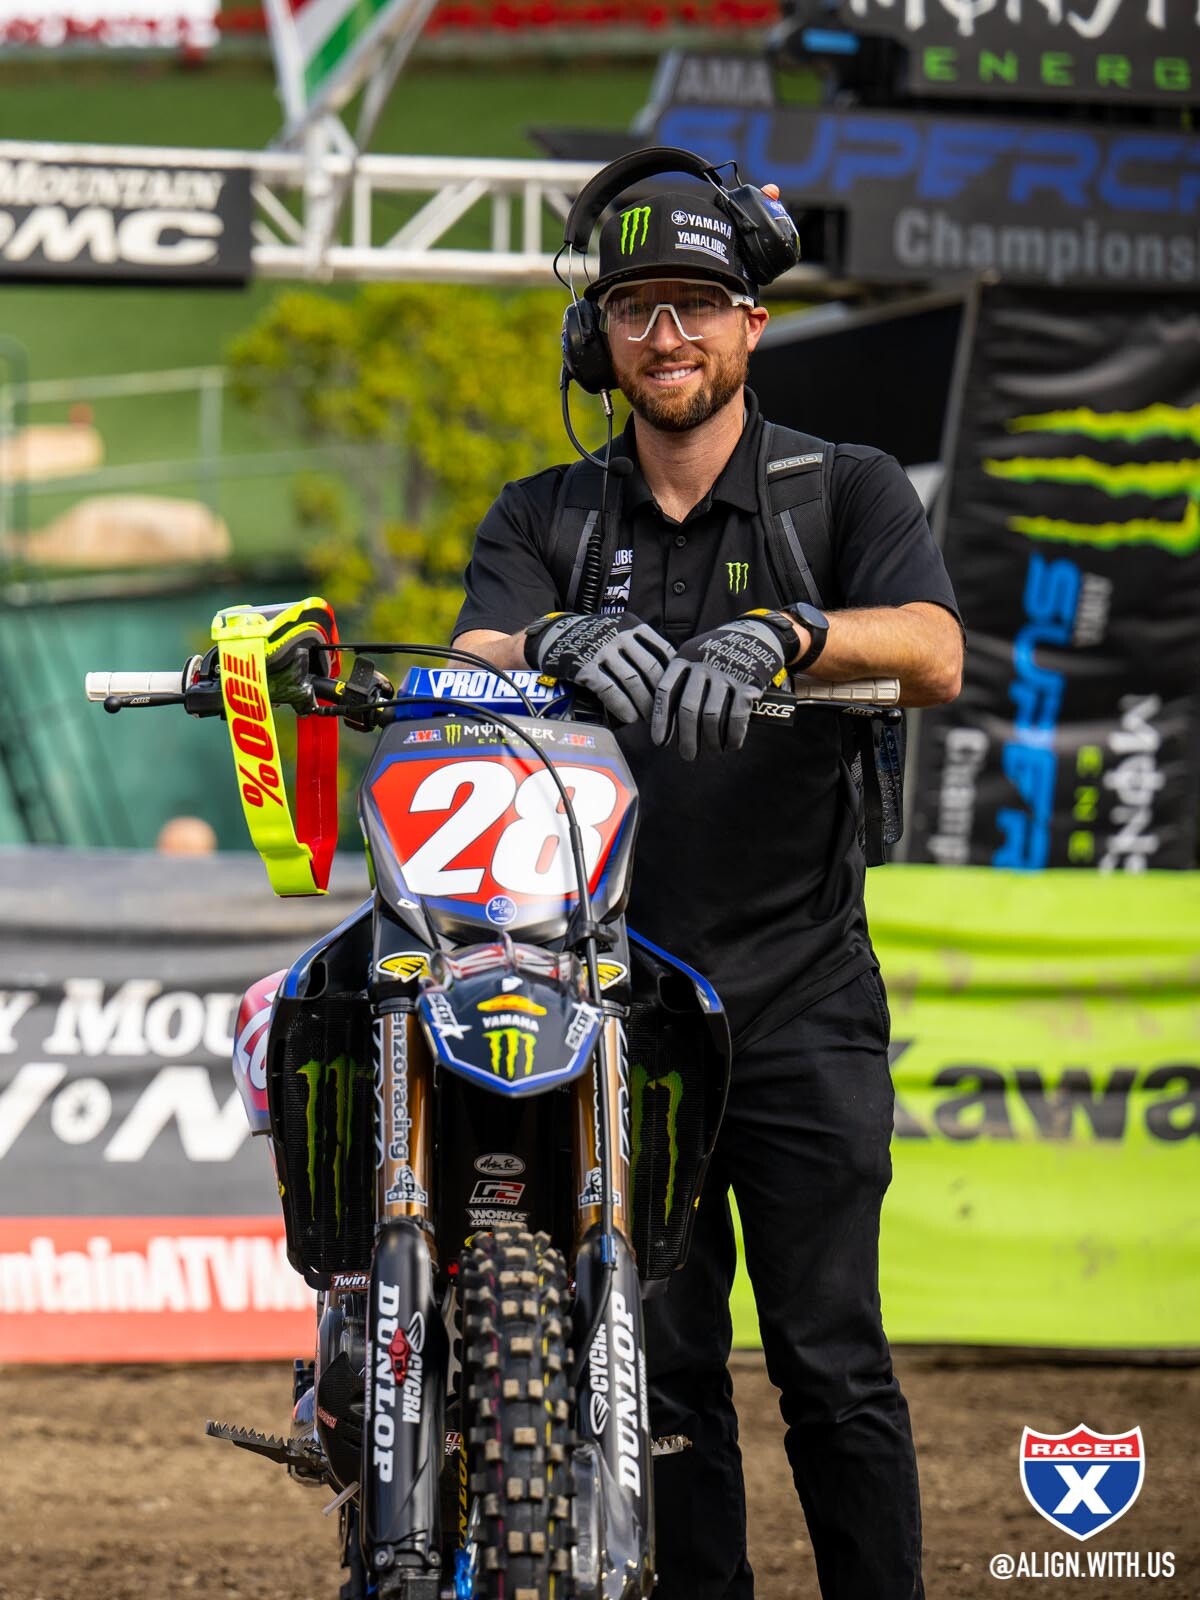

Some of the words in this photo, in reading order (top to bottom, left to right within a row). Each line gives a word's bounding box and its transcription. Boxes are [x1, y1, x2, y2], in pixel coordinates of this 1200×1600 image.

[922, 45, 1193, 91] ENERG
[657, 108, 1200, 215] SUPERC
[688, 214, 732, 240] YAMAHA
[677, 231, 727, 257] YAMALUBE
[893, 206, 1200, 285] Champions
[698, 638, 758, 671] Mechanix
[720, 632, 776, 668] Mechanix
[403, 730, 442, 744] AMA
[558, 733, 596, 748] AMA
[400, 760, 617, 896] 28
[482, 1013, 539, 1032] YAMAHA
[388, 1191, 427, 1202] enzo
[468, 1209, 528, 1222] WORKS
[334, 1275, 367, 1288] Twin
[374, 1280, 400, 1483] DUNLOP
[618, 1290, 642, 1498] DUNLOP
